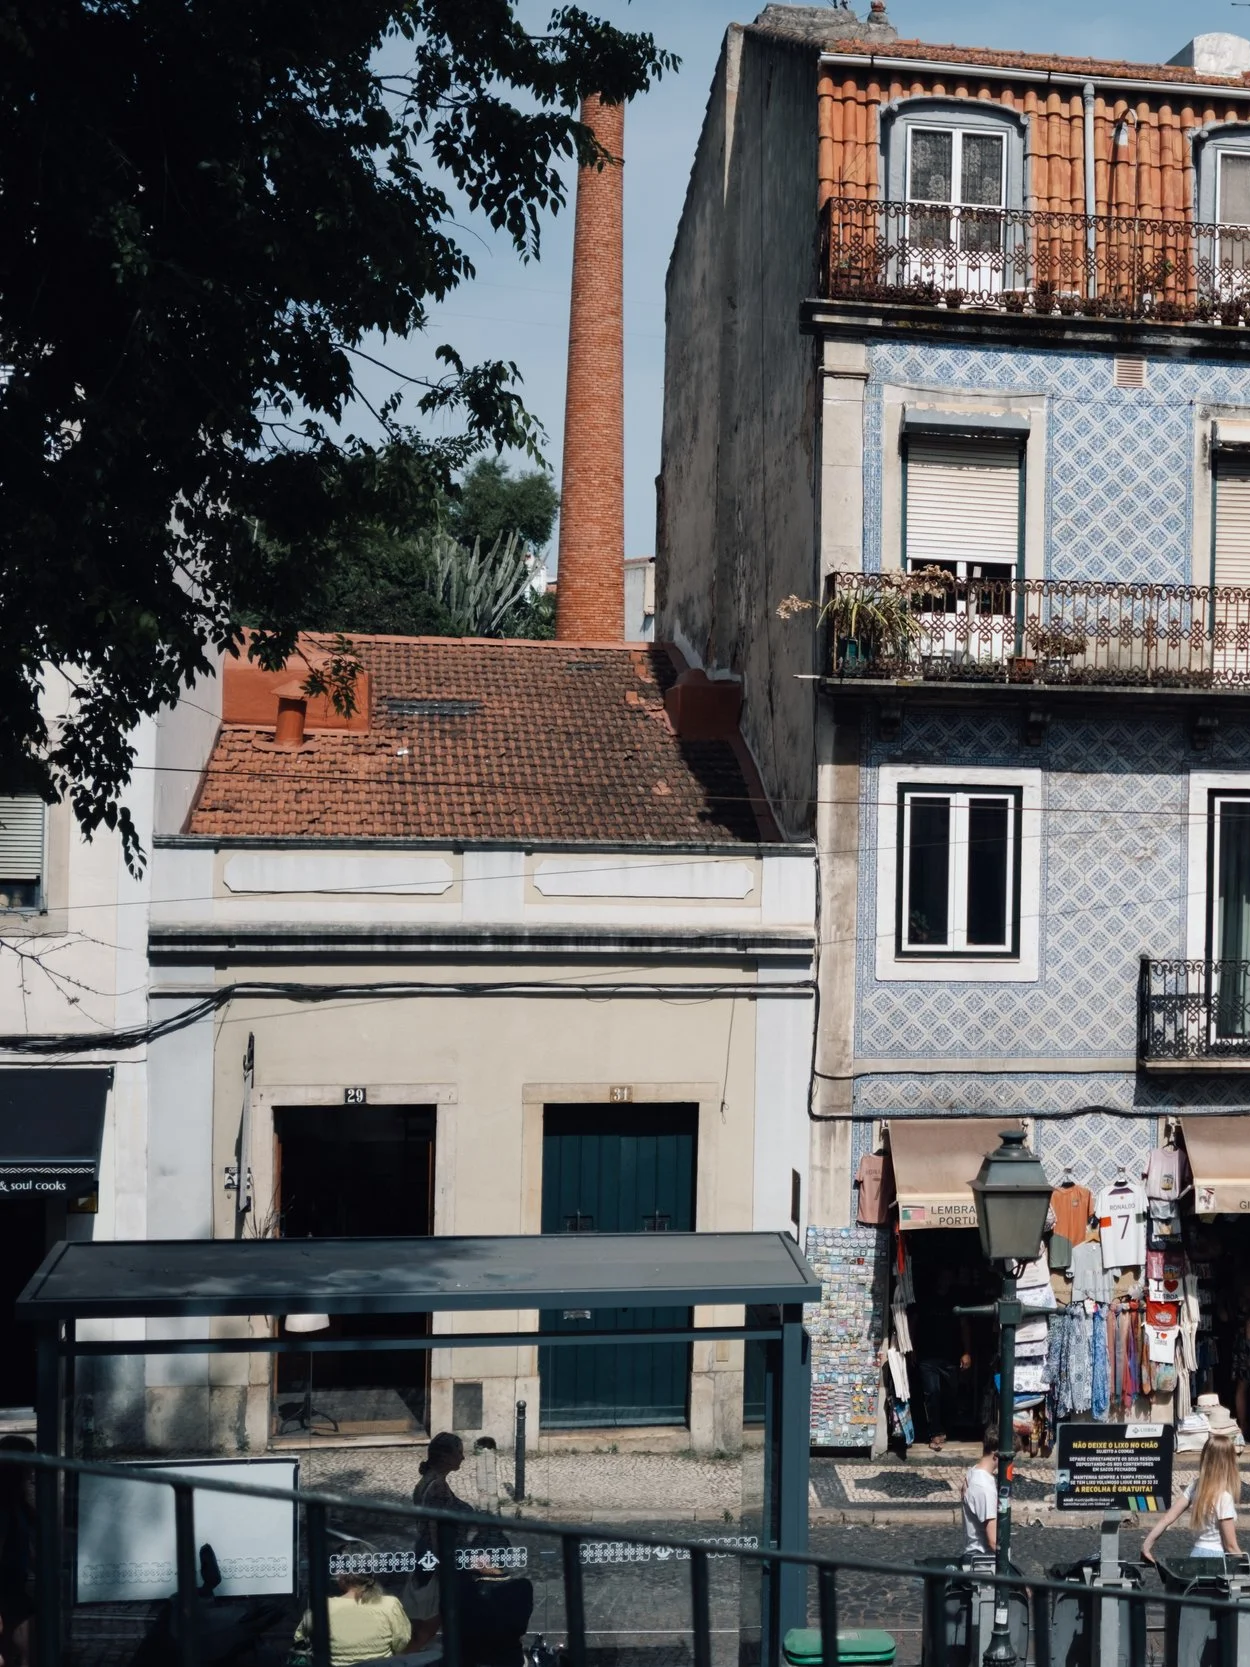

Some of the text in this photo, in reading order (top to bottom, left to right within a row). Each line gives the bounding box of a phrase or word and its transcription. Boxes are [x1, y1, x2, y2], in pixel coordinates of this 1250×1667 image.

[348, 1088, 363, 1103] 29
[613, 1087, 628, 1101] 31
[10, 1180, 33, 1191] soul
[35, 1180, 67, 1191] cooks
[930, 1205, 977, 1215] LEMBRA
[1109, 1203, 1136, 1211] RONALDO
[939, 1216, 978, 1226] PORTU
[1117, 1214, 1130, 1240] 7
[1072, 1441, 1087, 1449] NÃO
[1140, 1440, 1159, 1449] CHÃO
[1112, 1485, 1117, 1493] É
[1117, 1485, 1153, 1493] GRATUITA!
